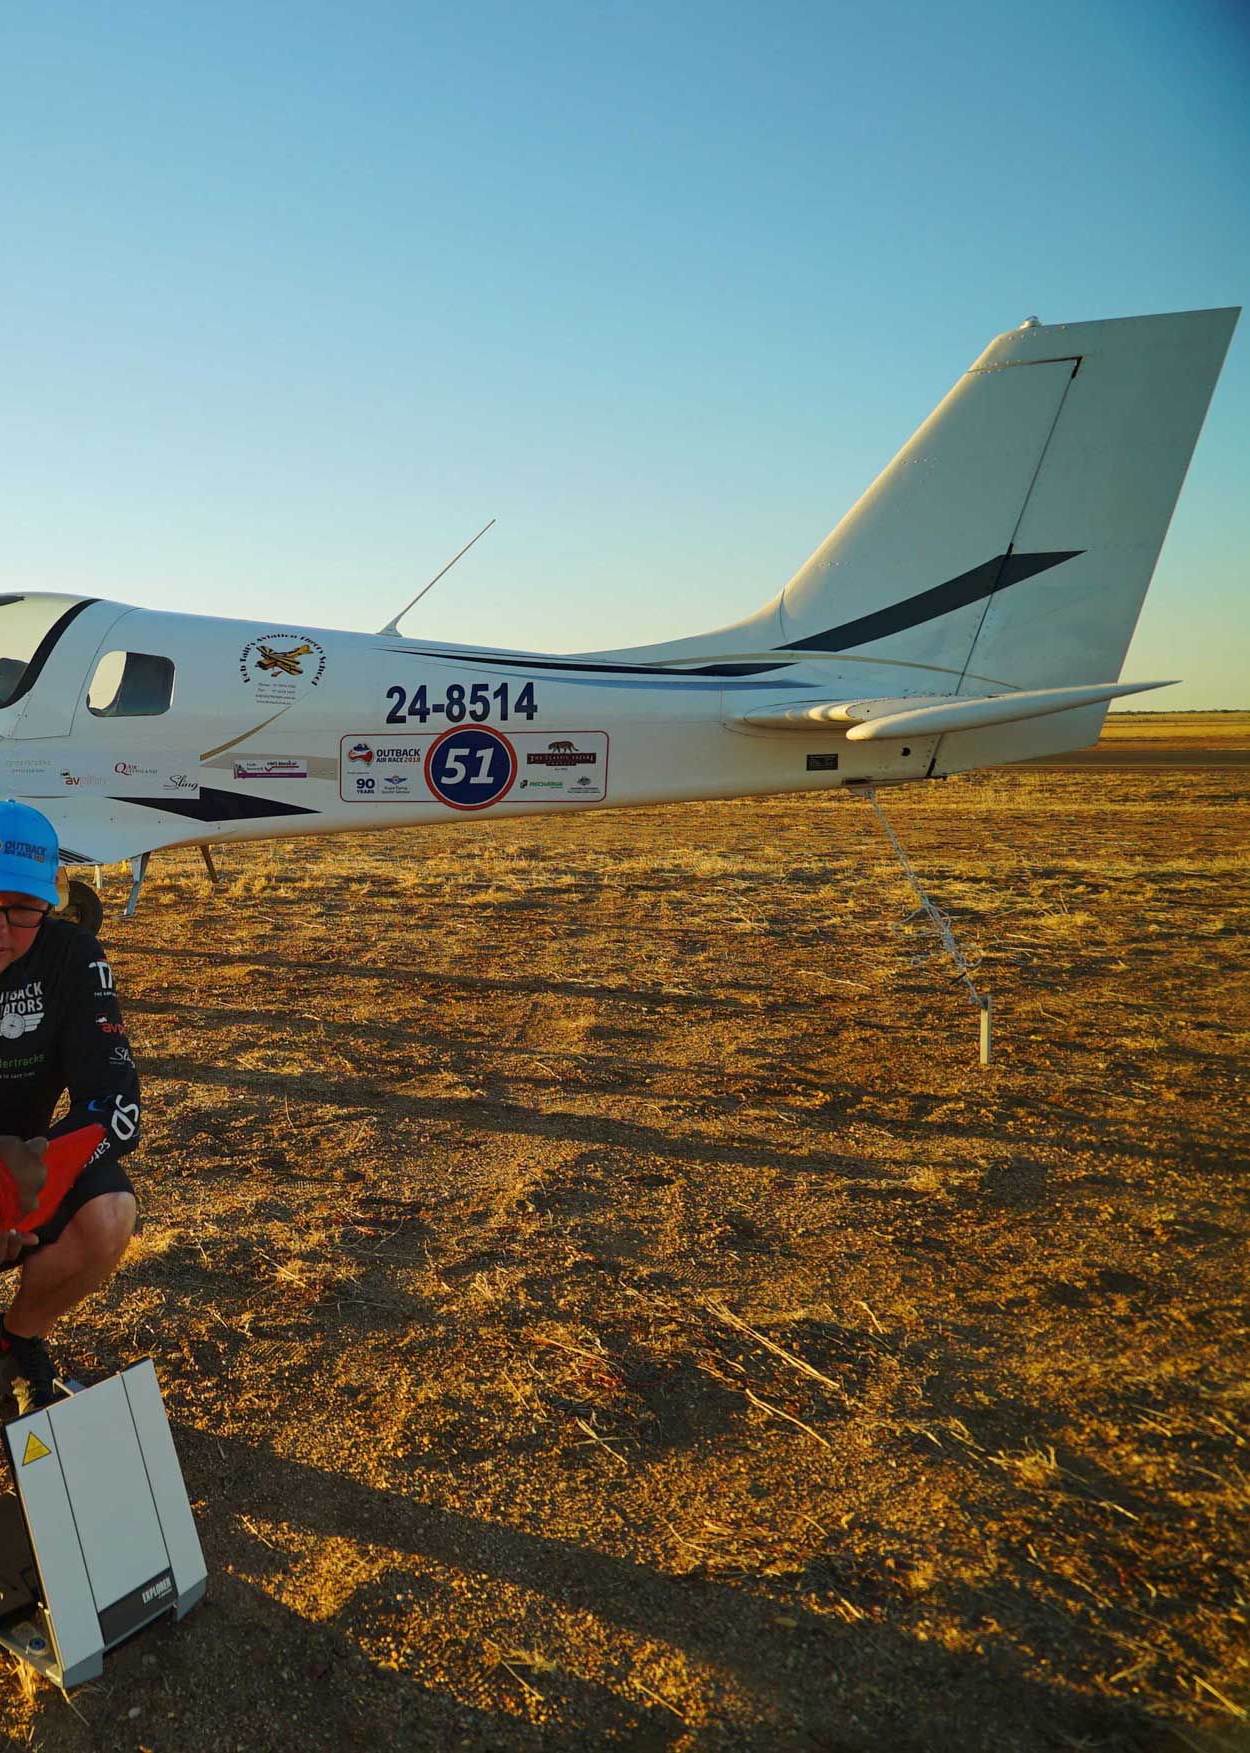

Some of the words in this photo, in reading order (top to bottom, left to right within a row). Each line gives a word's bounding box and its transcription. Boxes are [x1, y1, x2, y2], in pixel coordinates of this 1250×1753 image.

[386, 682, 538, 724] 24-8514
[376, 749, 421, 757] OUTBACK
[440, 747, 495, 785] 51
[163, 774, 199, 791] Sling
[356, 778, 375, 789] 90
[4, 840, 47, 856] OUTBACK
[111, 1094, 140, 1140] SD
